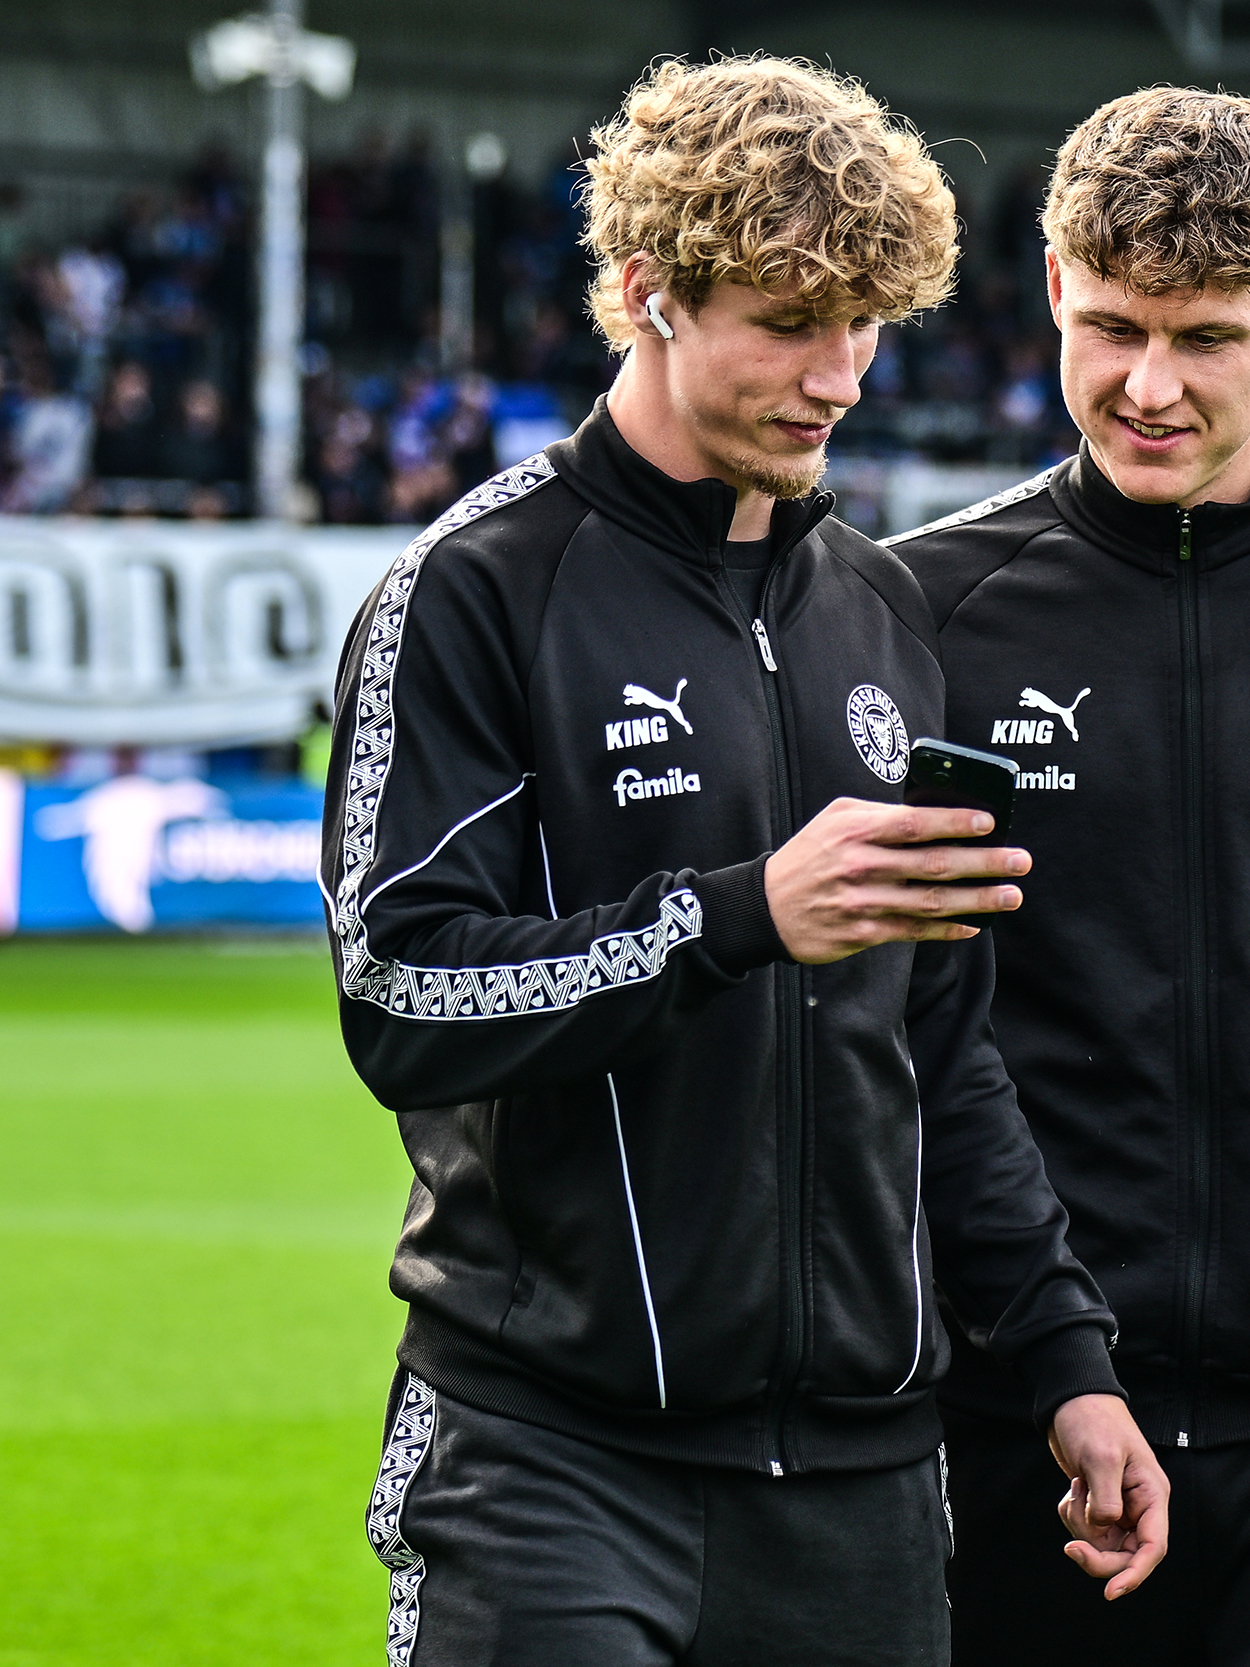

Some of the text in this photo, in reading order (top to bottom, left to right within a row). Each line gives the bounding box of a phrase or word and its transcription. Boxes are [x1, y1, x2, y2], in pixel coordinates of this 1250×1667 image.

[605, 715, 669, 751] KING
[850, 695, 868, 746] KIELER
[874, 690, 908, 755] HOLSTEIN
[990, 719, 1054, 744] KING
[867, 748, 906, 779] VON 1900
[1015, 765, 1076, 790] mila
[613, 768, 701, 807] famila
